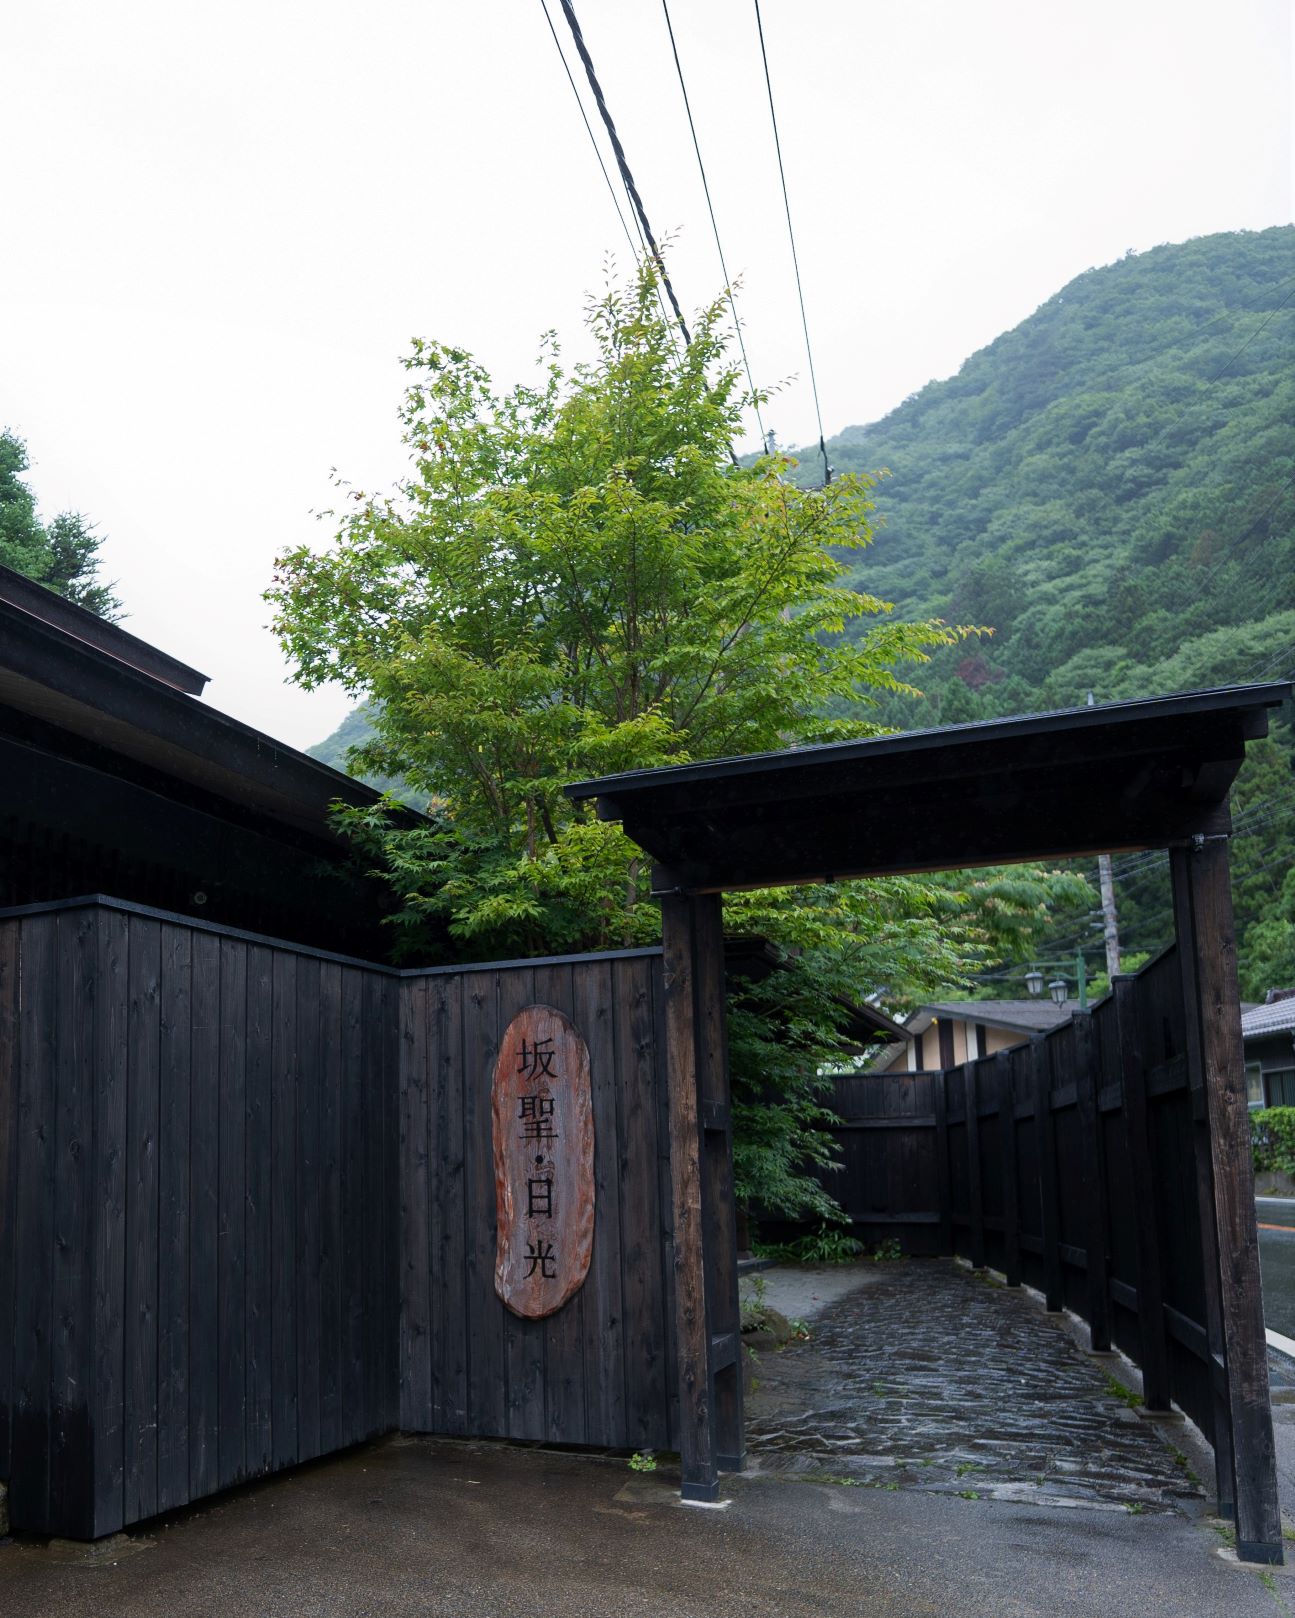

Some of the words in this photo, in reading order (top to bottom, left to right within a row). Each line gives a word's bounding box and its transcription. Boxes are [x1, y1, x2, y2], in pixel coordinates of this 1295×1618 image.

[516, 1038, 559, 1280] 坂聖・日光
